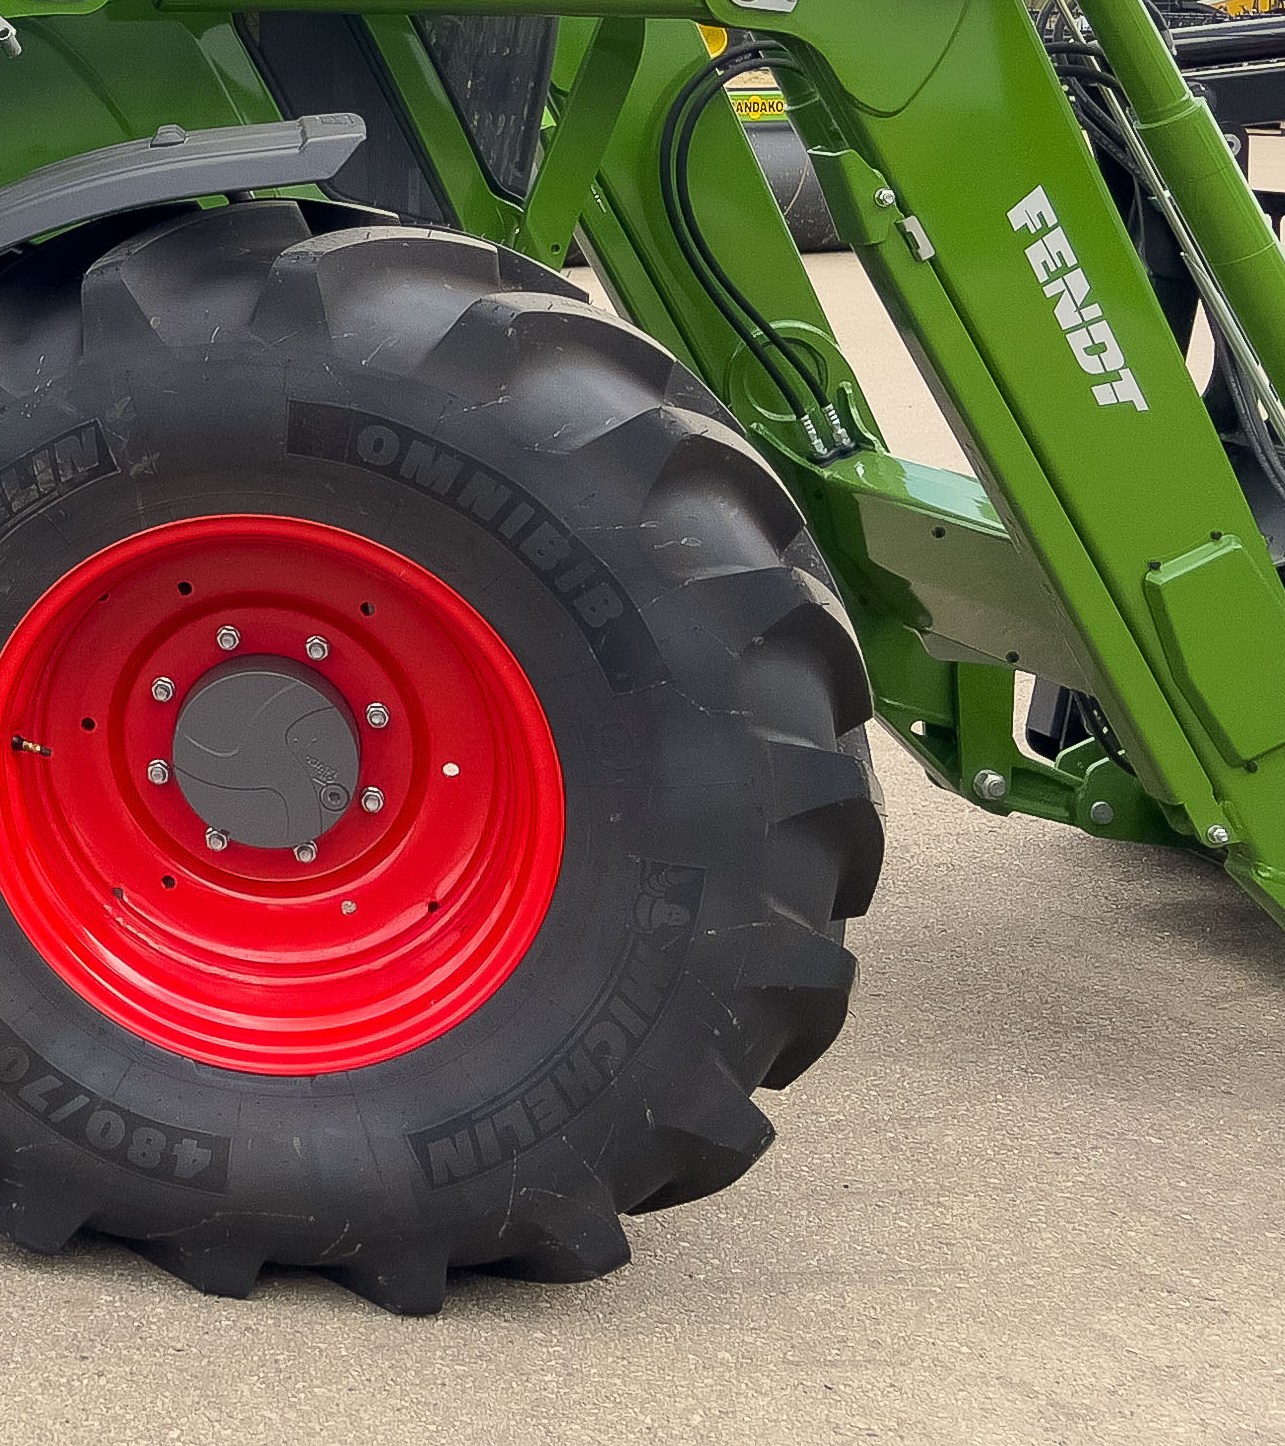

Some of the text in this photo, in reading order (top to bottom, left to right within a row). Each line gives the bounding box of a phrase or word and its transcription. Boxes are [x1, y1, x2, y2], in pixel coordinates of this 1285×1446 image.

[733, 101, 784, 113] ANDAKO
[1006, 184, 1149, 412] FENDT
[356, 425, 625, 628] OMNIBIB
[427, 940, 663, 1186] MICHELIN
